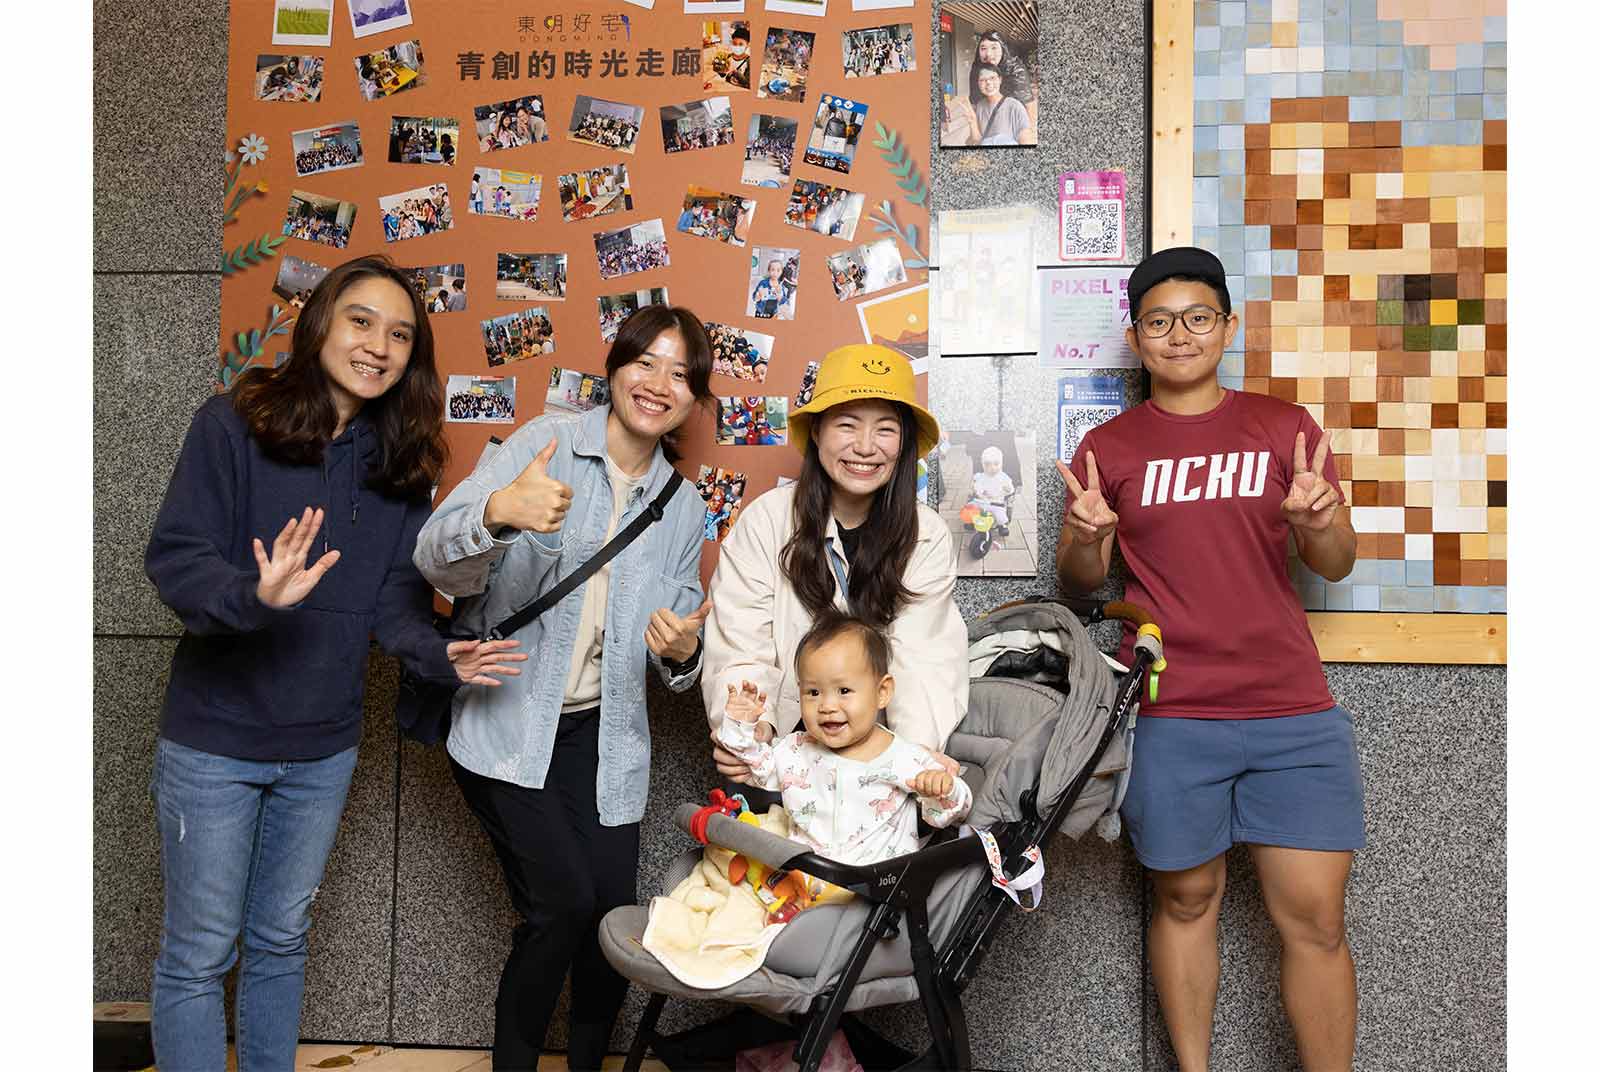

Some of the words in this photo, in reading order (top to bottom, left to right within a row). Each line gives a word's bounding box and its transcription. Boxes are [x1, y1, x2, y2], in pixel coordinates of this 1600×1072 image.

[455, 48, 702, 81] 青創的時光走廊
[1051, 279, 1113, 295] PIXEL
[1141, 451, 1271, 507] NCKU
[878, 872, 898, 887] Joie
